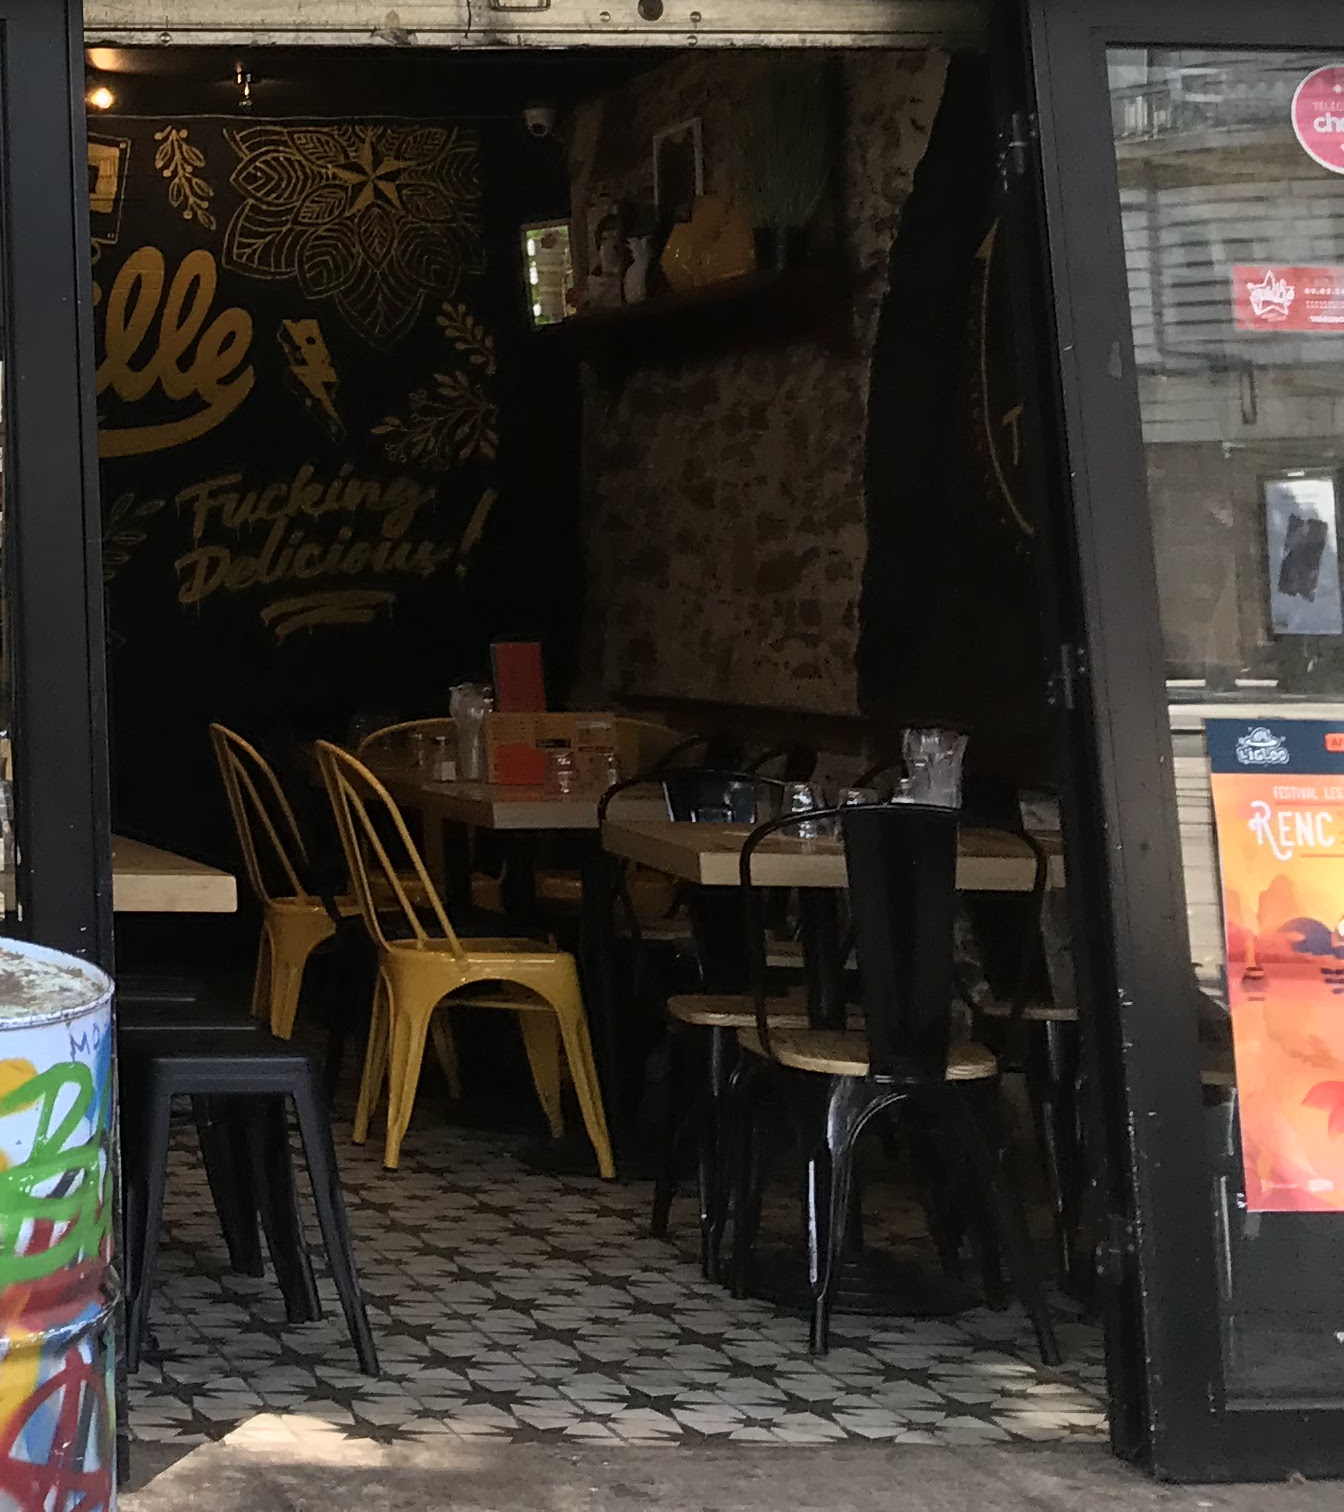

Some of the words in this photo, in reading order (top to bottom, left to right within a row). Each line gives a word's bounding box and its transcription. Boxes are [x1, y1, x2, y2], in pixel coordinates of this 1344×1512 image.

[94, 245, 255, 456] lle
[175, 463, 436, 540] Fucking
[1274, 786, 1318, 800] FESTIVAL
